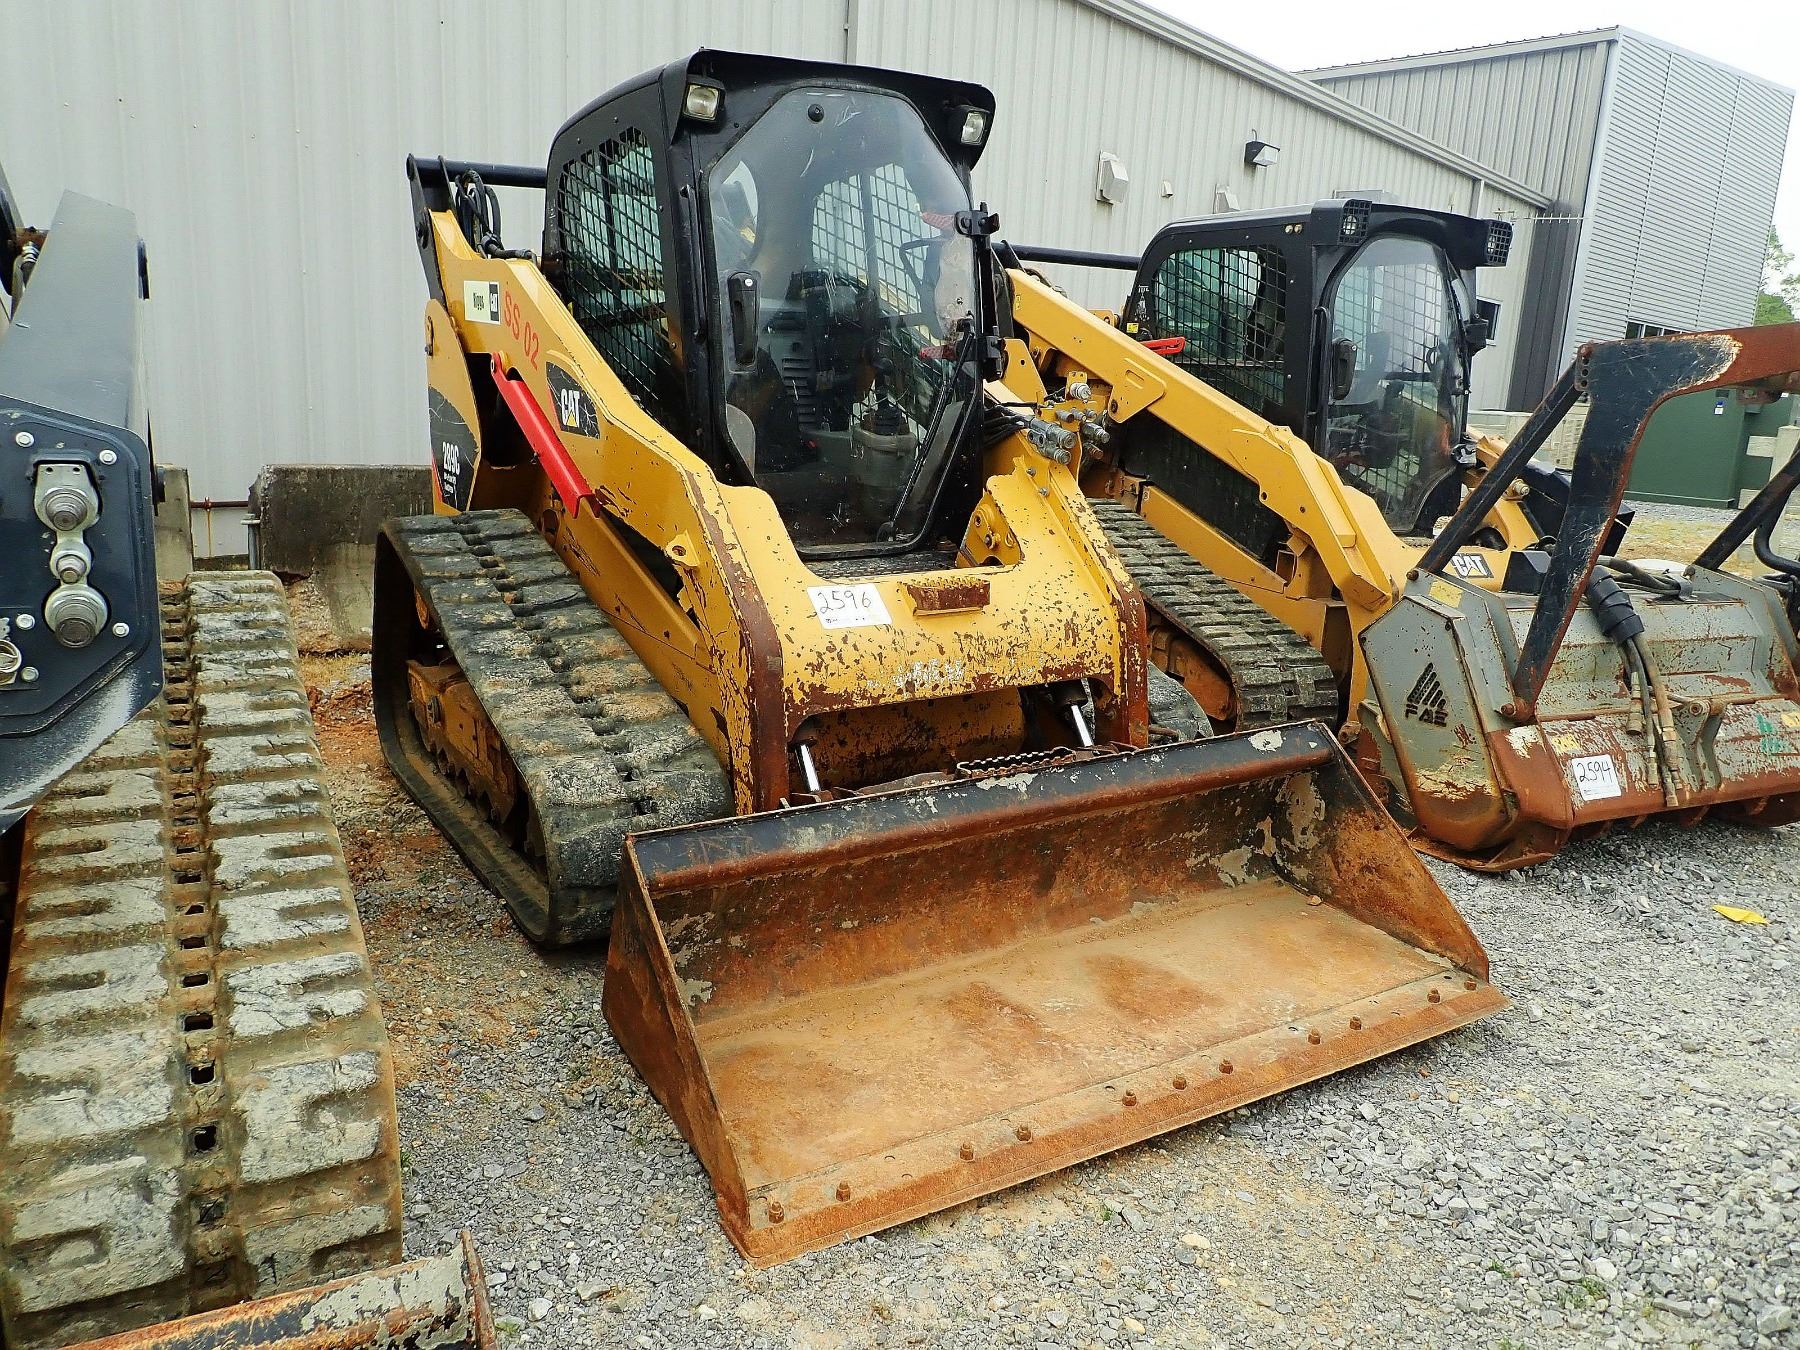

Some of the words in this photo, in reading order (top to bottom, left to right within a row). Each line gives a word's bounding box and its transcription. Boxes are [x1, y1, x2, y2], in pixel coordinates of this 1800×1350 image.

[504, 291, 520, 340] SS
[524, 322, 539, 371] 02
[561, 388, 580, 428] CAT
[442, 441, 460, 475] 289C
[1452, 555, 1488, 577] CAT
[817, 589, 872, 614] 2596
[1405, 703, 1448, 727] FAE
[1576, 760, 1613, 783] 2594
